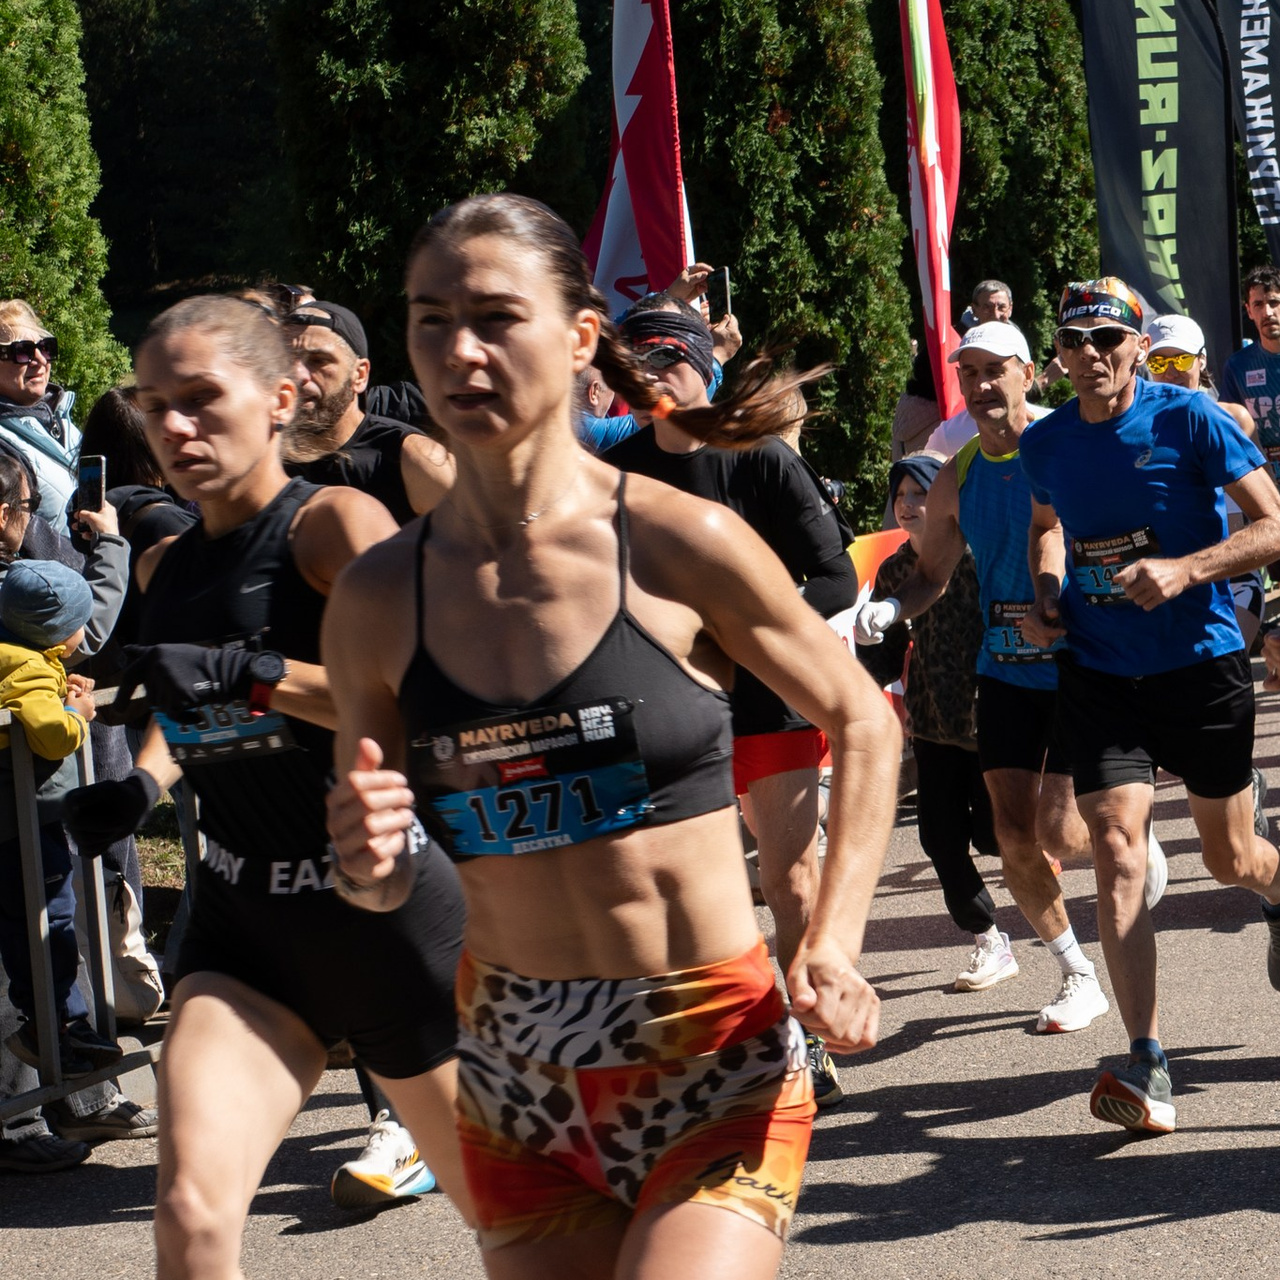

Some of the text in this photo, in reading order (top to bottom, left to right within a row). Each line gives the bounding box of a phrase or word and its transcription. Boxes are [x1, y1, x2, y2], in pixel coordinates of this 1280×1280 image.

[1083, 536, 1130, 550] MAYRVEDA
[1090, 564, 1128, 589] 14
[459, 712, 576, 747] MAYRVEDA
[467, 775, 604, 842] 1271
